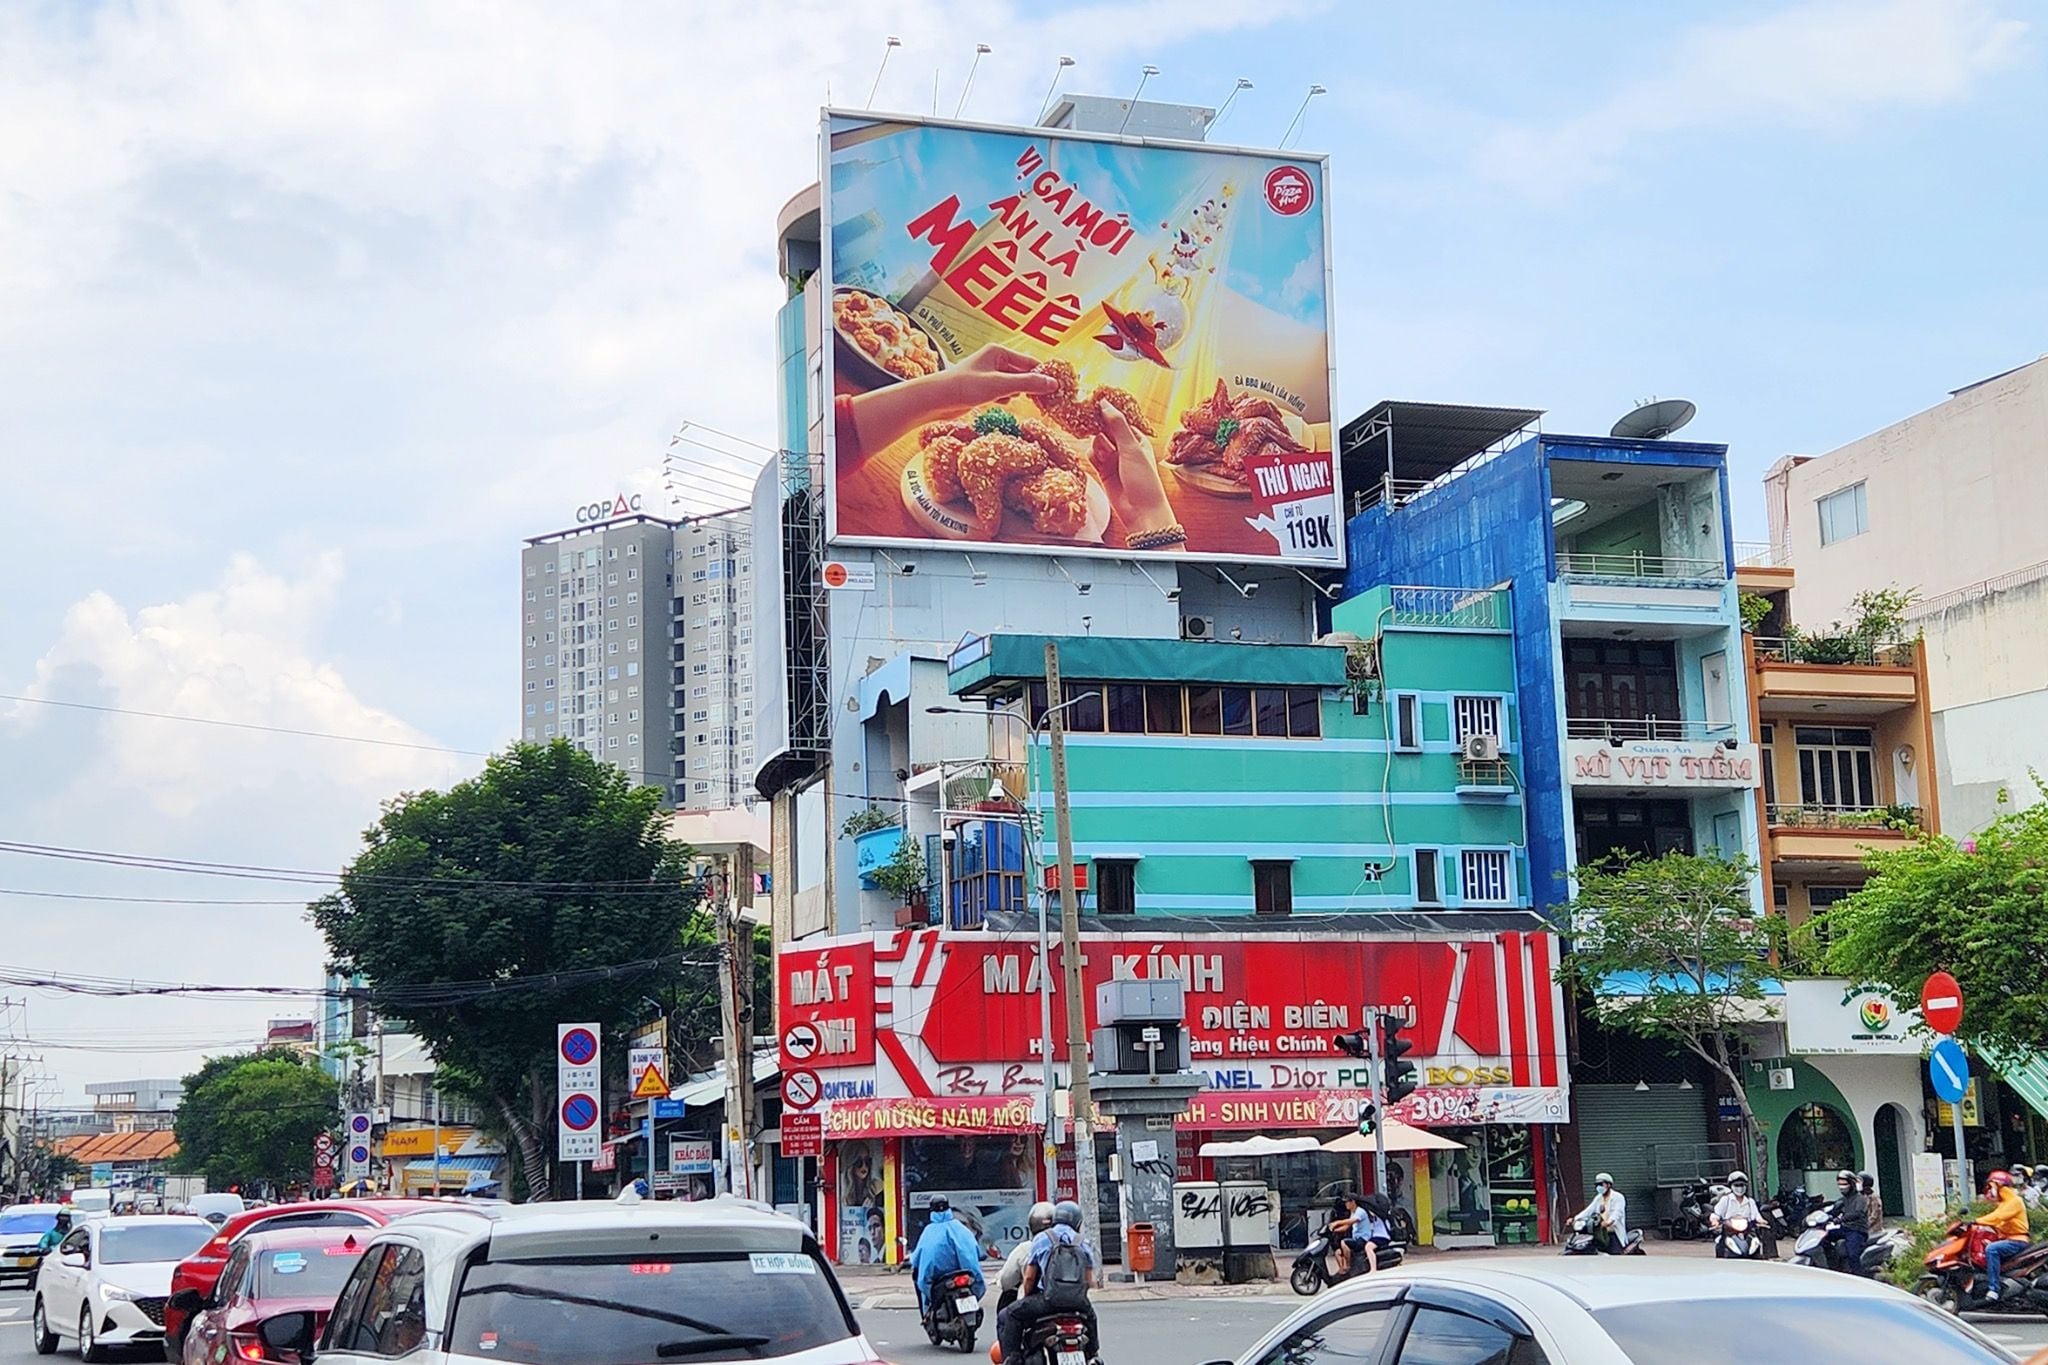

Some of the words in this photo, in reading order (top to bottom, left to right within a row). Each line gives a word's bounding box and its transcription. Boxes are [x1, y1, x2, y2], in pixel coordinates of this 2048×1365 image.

[1016, 145, 1043, 181] VỊ
[1033, 170, 1078, 216] GÀ
[1062, 200, 1135, 256] MỚI
[1273, 186, 1303, 199] Pizza
[988, 190, 1039, 241] ĂN
[1028, 231, 1086, 278] LÀ
[1254, 457, 1289, 498] THỬ
[1288, 461, 1331, 492] NGAY!
[1286, 514, 1334, 549] 119K
[1576, 749, 1611, 778] MÌ
[1619, 756, 1670, 784] VỊT
[1680, 746, 1752, 780] TIỀM
[791, 951, 853, 1006] MẮT
[1112, 944, 1224, 992] KÍNH
[1202, 1000, 1270, 1035] ĐIỆN
[1284, 999, 1349, 1029] BIÊN
[1229, 1035, 1270, 1056] Hiệu
[1276, 1035, 1328, 1053] Chính
[936, 1065, 988, 1095] Ray
[1002, 1064, 1044, 1092] Ban
[1270, 1064, 1328, 1090] Dior
[1426, 1066, 1511, 1086] BOSS
[832, 1105, 871, 1131] CHÚC
[942, 1103, 987, 1126] NĂM
[1221, 1102, 1268, 1122] SINH
[1272, 1097, 1316, 1122] VIÊN
[1411, 1096, 1470, 1121] 30%
[753, 1257, 766, 1268] XE
